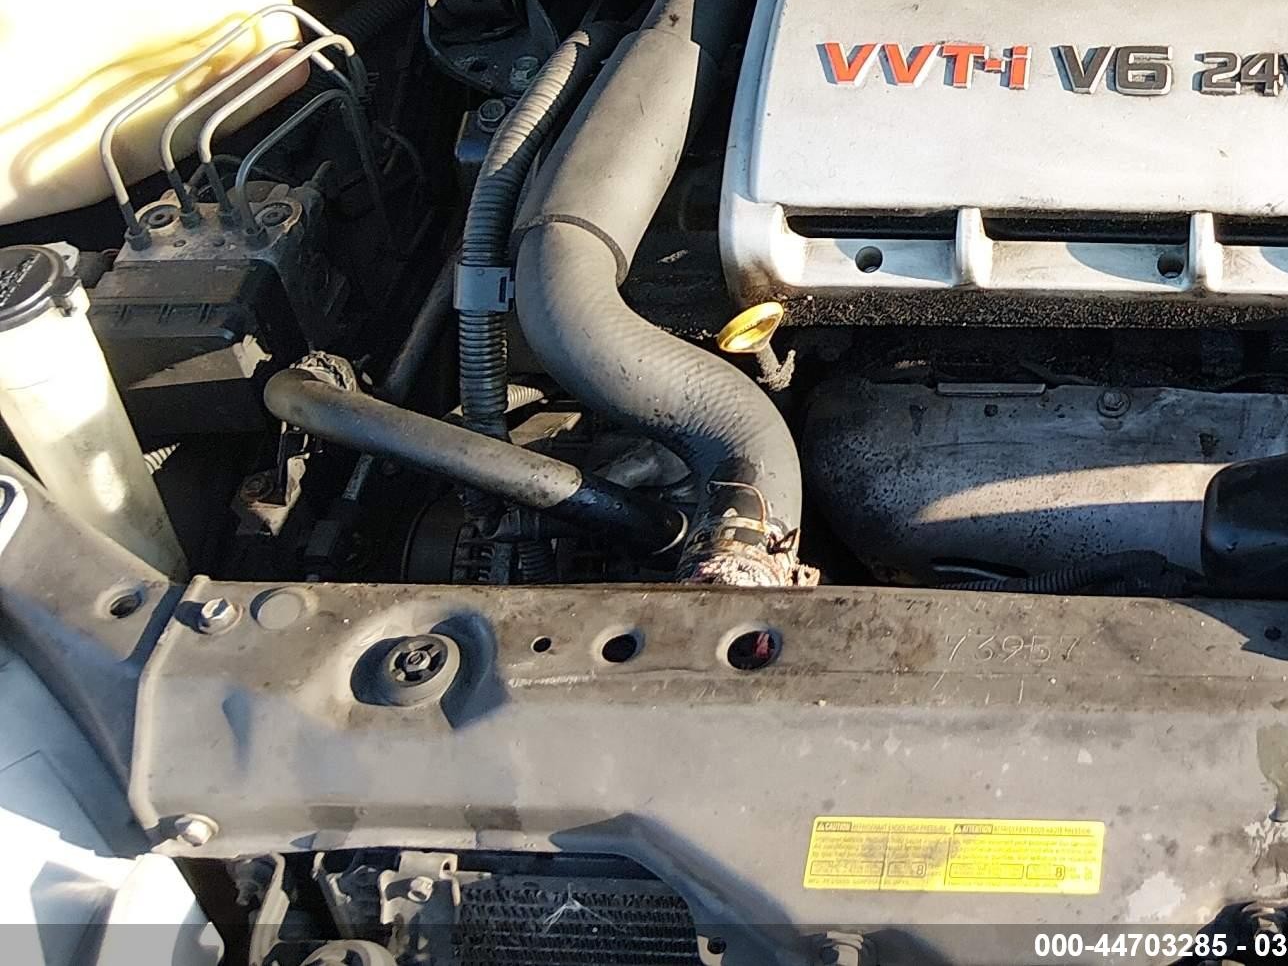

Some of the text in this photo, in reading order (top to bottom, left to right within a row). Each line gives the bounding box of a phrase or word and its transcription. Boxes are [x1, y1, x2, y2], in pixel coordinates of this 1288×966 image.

[818, 41, 1032, 90] VVT-i
[1051, 44, 1175, 96] V6
[825, 822, 851, 832] CAUTION
